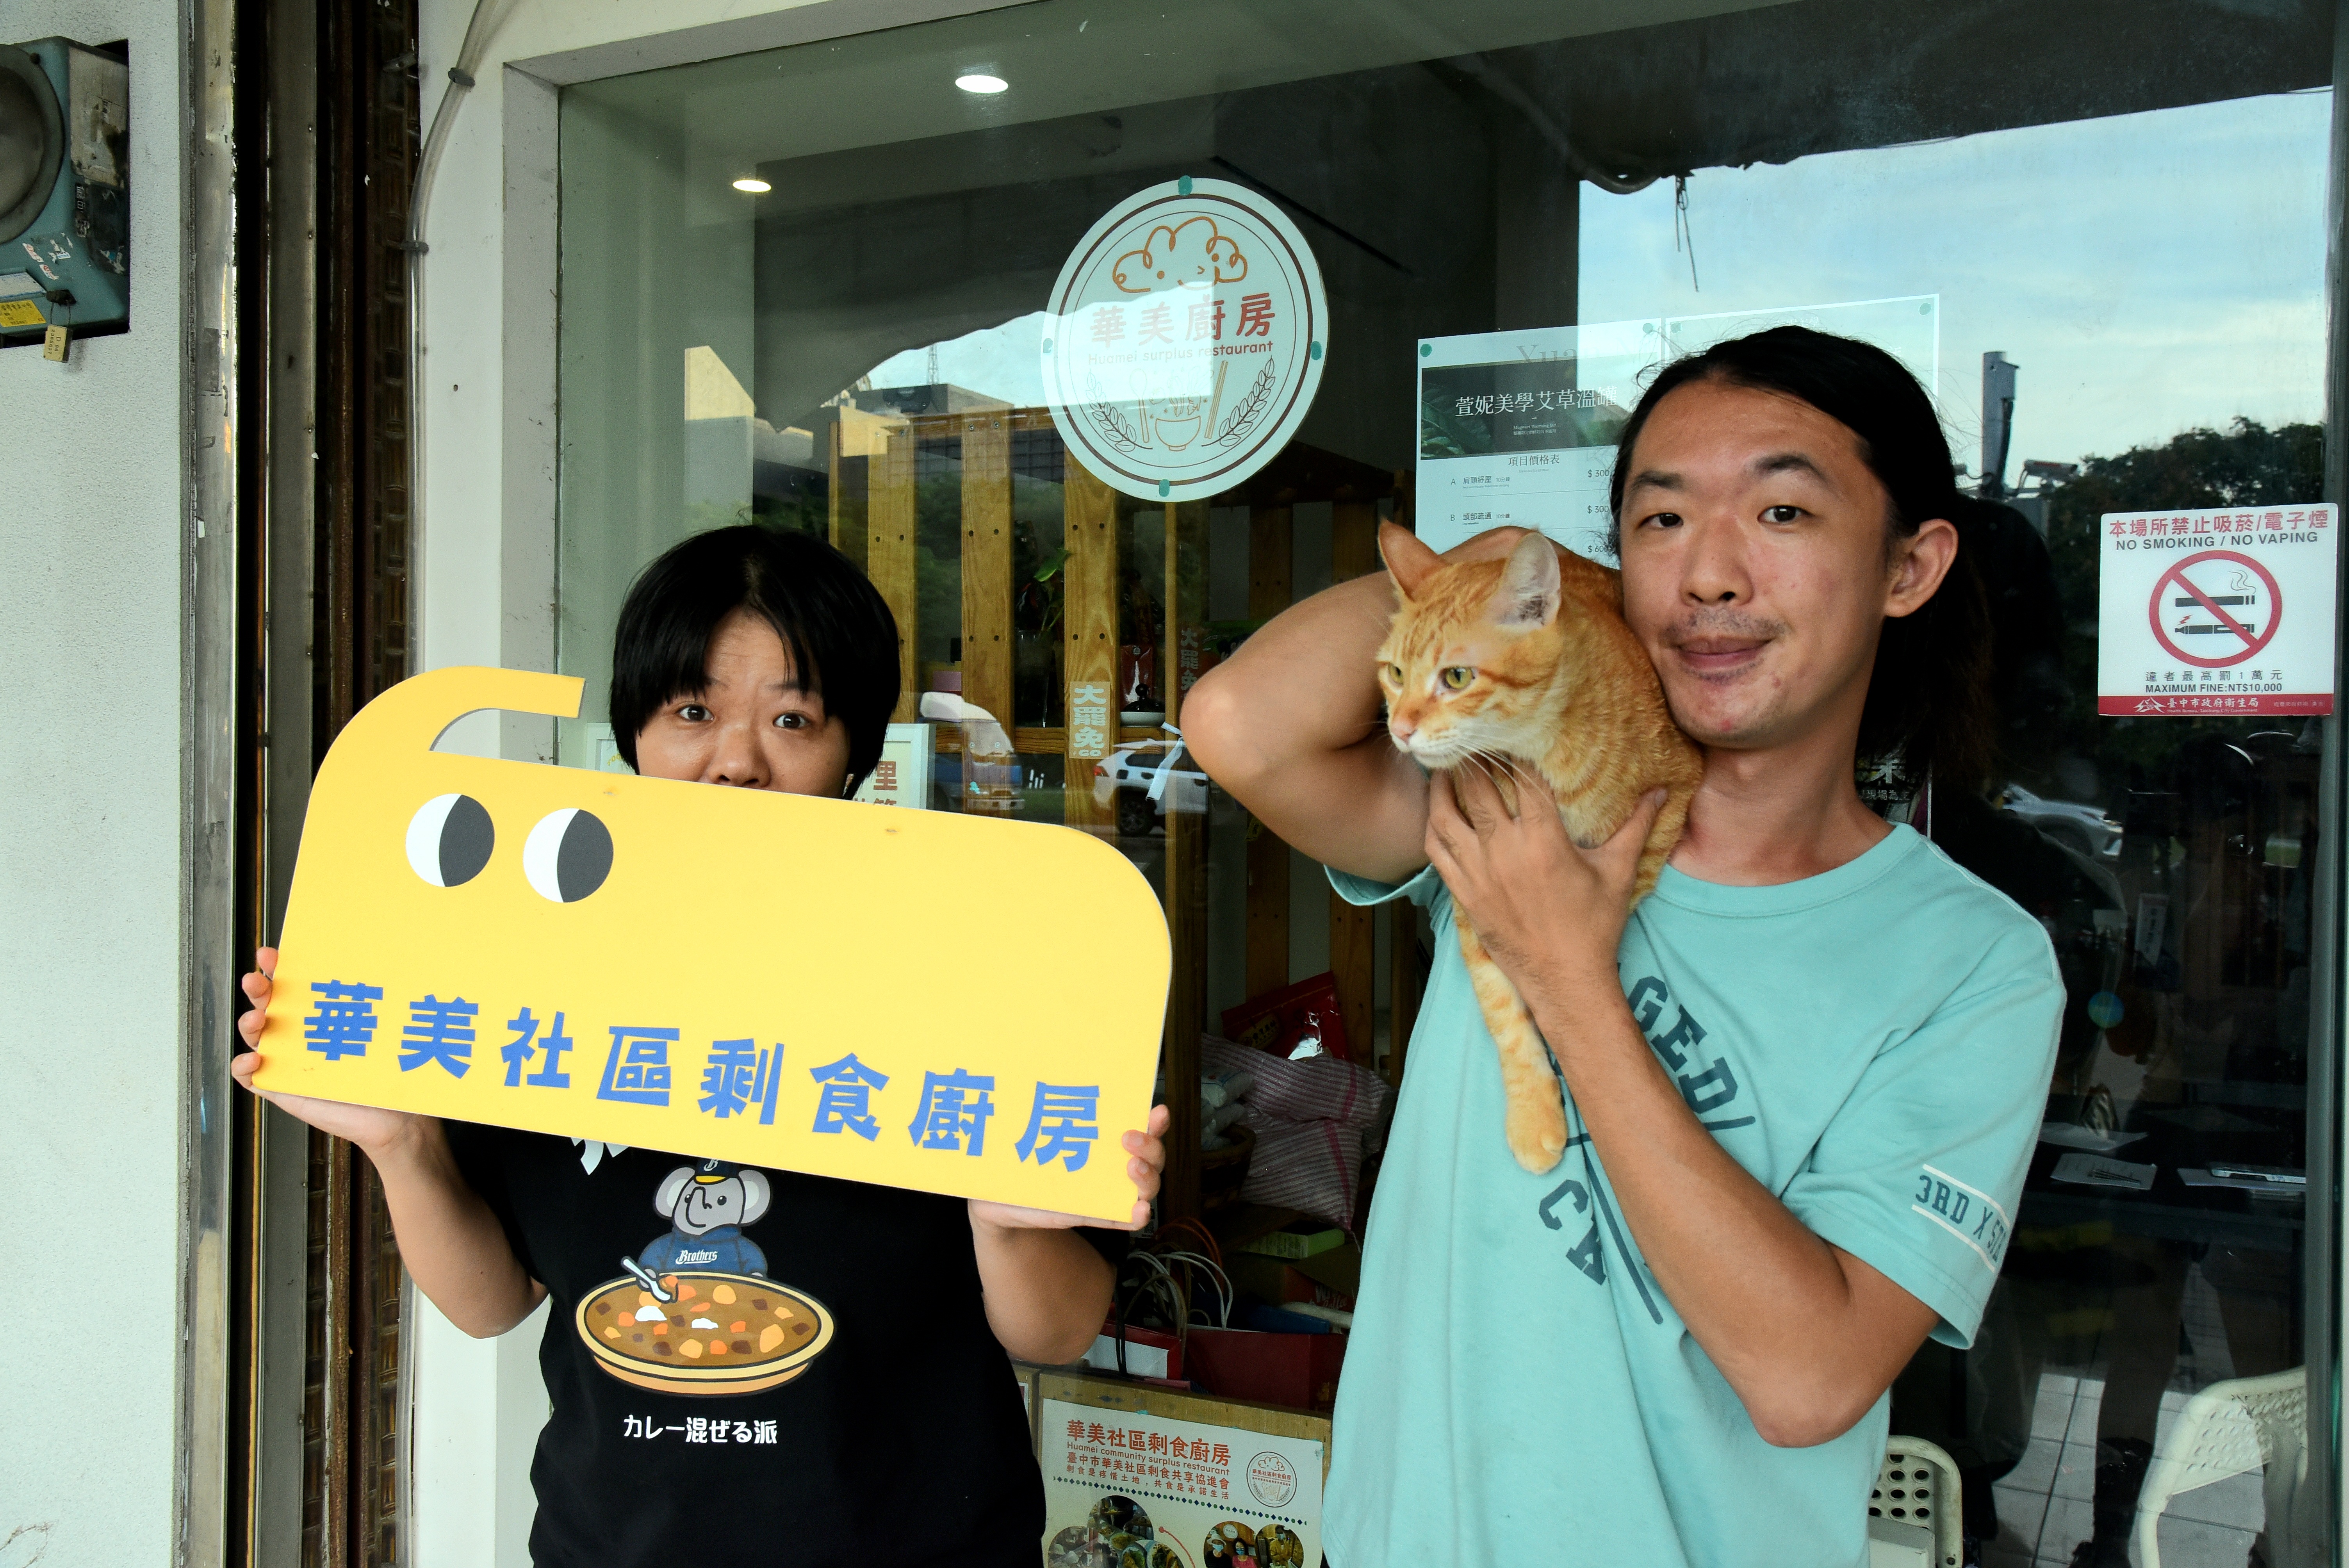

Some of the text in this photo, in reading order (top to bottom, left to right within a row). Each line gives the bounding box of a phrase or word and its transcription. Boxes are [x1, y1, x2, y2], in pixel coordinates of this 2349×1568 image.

[1089, 292, 1276, 348] 華美廚房
[1088, 341, 1274, 366] Huamei surplus restaurant
[1455, 386, 1617, 417] 萱妮美學艾草溫罐
[1508, 454, 1560, 467] 項目價格表
[1462, 512, 1492, 521] 頭部疏通
[2109, 510, 2329, 538] 本場所禁止吸菸/電子煙
[2116, 532, 2319, 550] NO SMOKING / NO VAPING
[2146, 684, 2196, 693] MAXIMUM
[2167, 697, 2259, 708] 臺中市政府衛生局
[1073, 684, 1107, 749] 大罷免
[304, 979, 1100, 1172] 華美社區剩食廚房
[1915, 1174, 1970, 1225] 3RD
[1973, 1206, 1993, 1240] X
[675, 1249, 718, 1264] Brothers
[624, 1414, 777, 1444] カレー混ぜる派
[1067, 1419, 1231, 1466] 華美社區剩食廚房
[1067, 1442, 1230, 1475] Huamei community surplus restaurant
[1068, 1452, 1230, 1490] 臺中市華美社區剩食共享協進會
